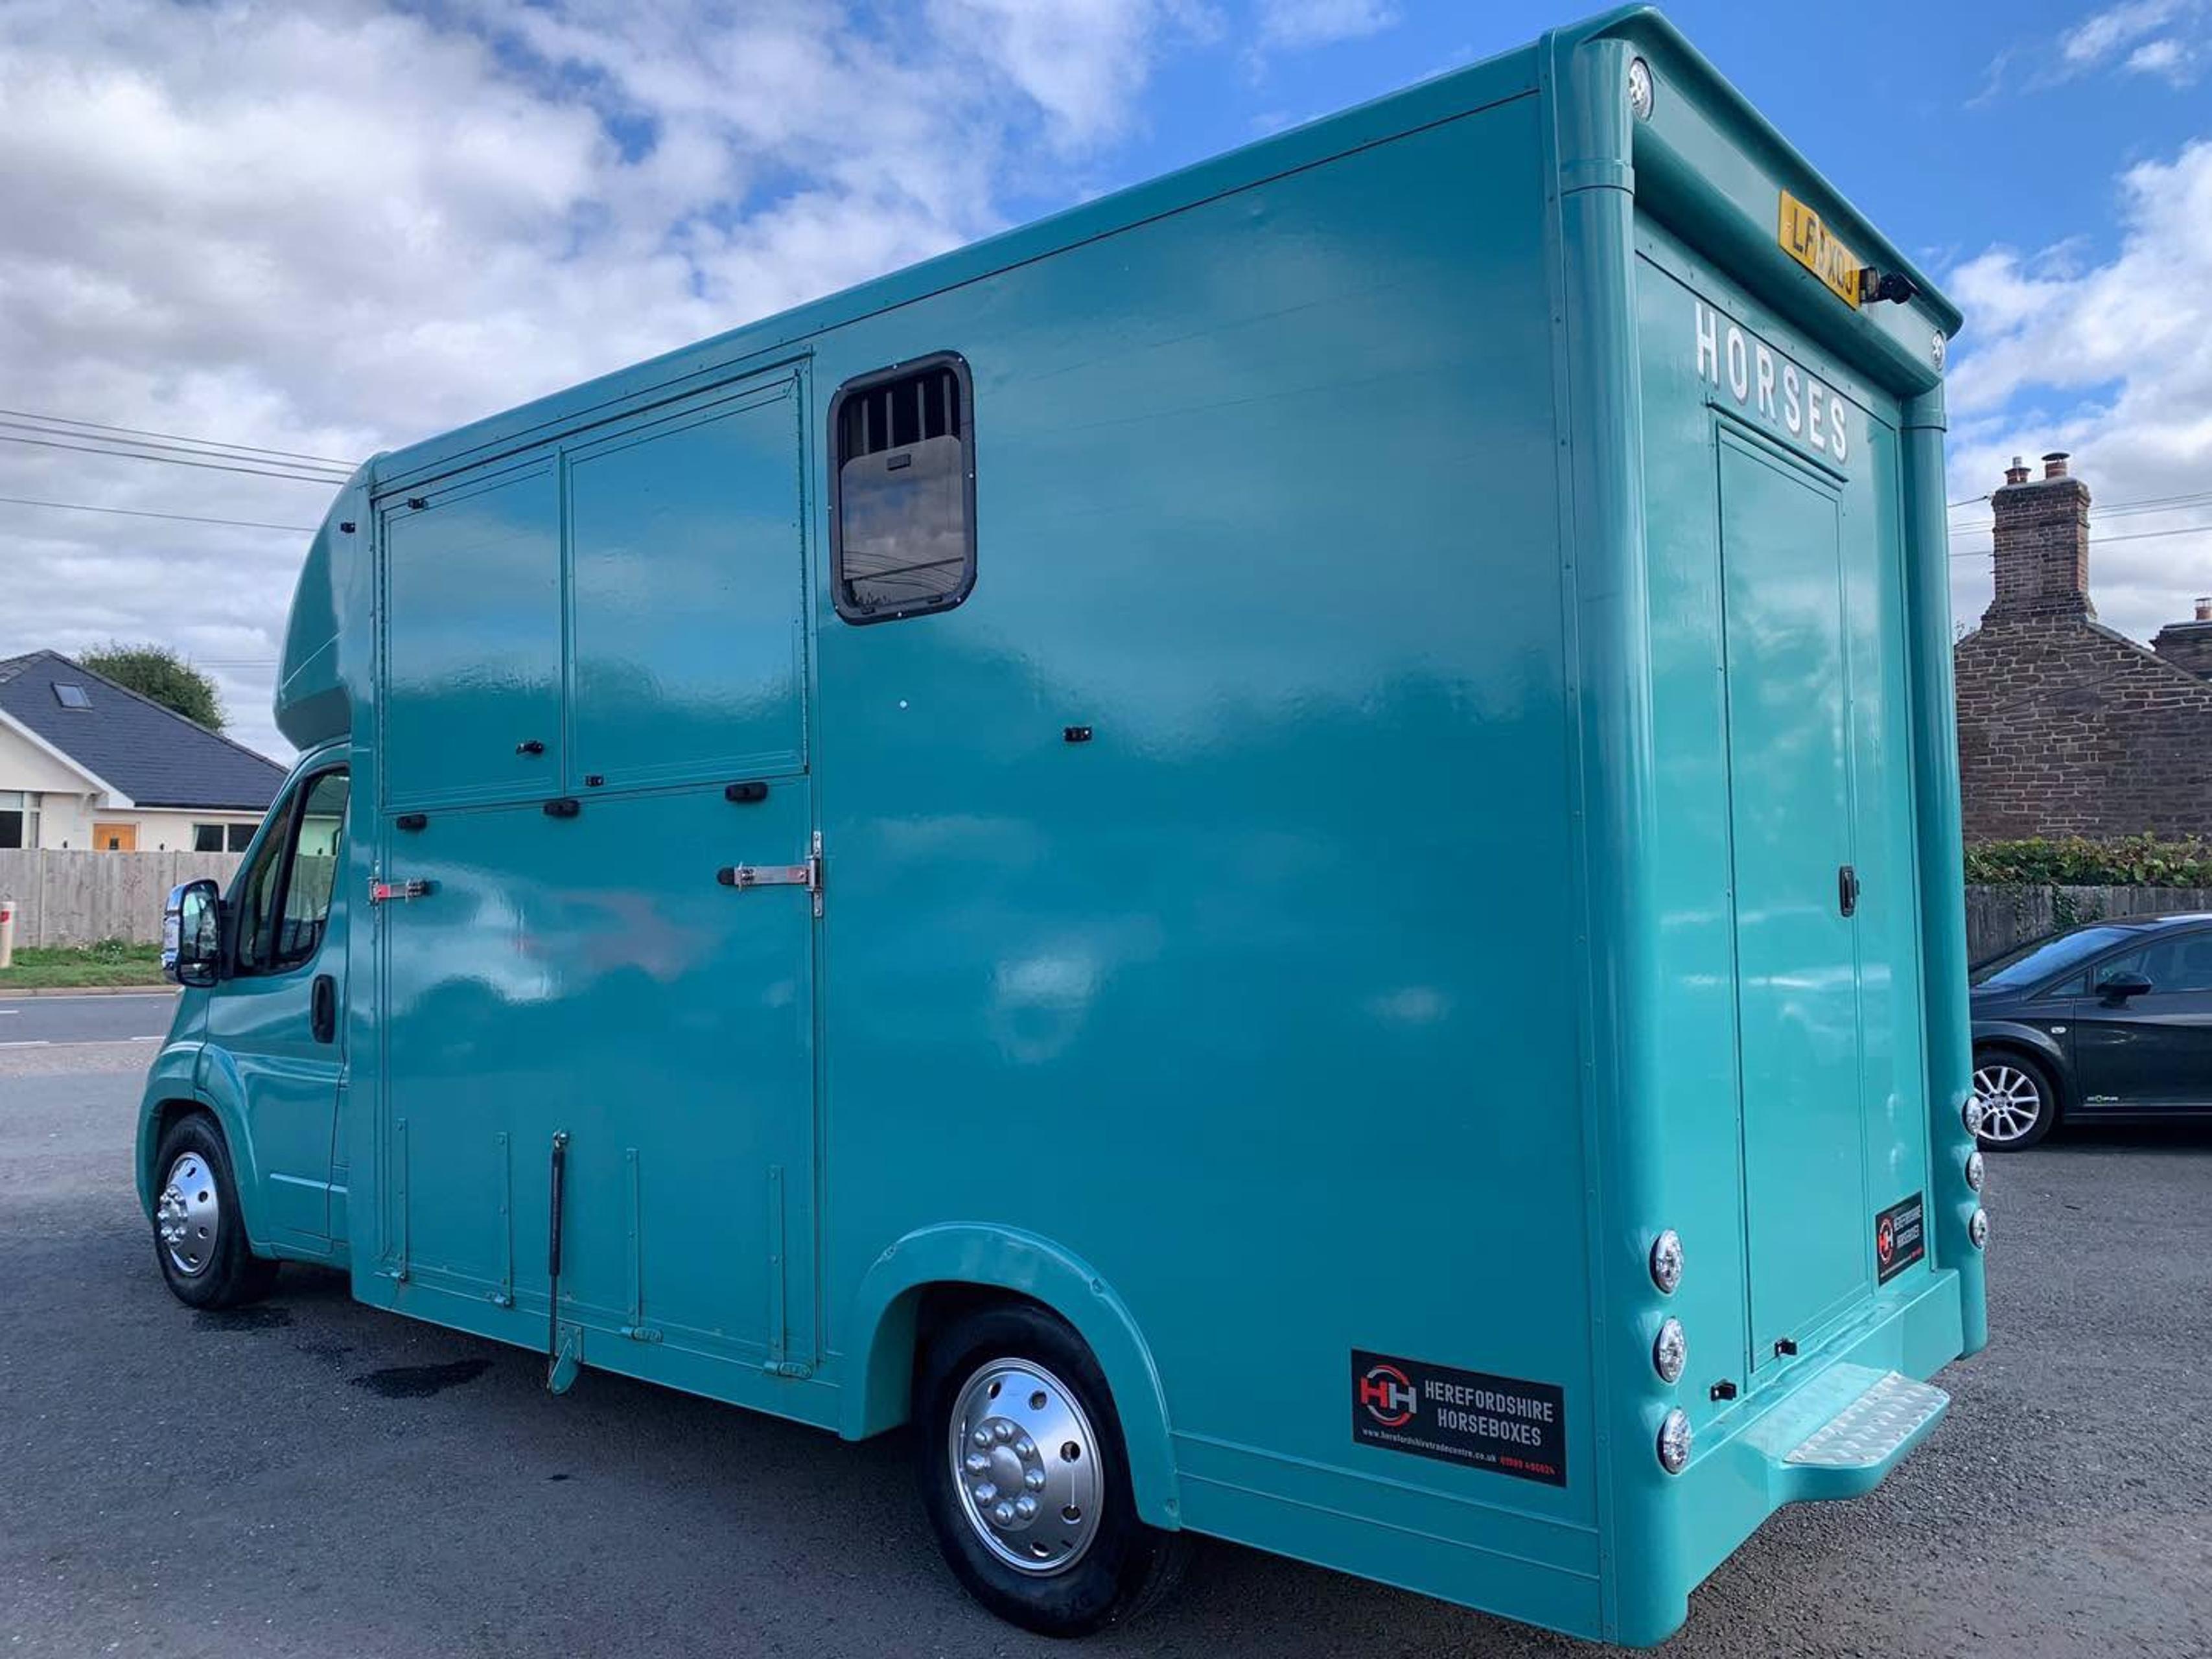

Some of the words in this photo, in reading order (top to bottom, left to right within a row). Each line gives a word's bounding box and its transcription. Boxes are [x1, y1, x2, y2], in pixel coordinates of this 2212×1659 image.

[1695, 301, 1846, 461] HORSES
[1361, 1376, 1417, 1414] HH
[1425, 1380, 1554, 1422] HEREFORDSHIRE
[1437, 1408, 1542, 1446] HORSEBOXES
